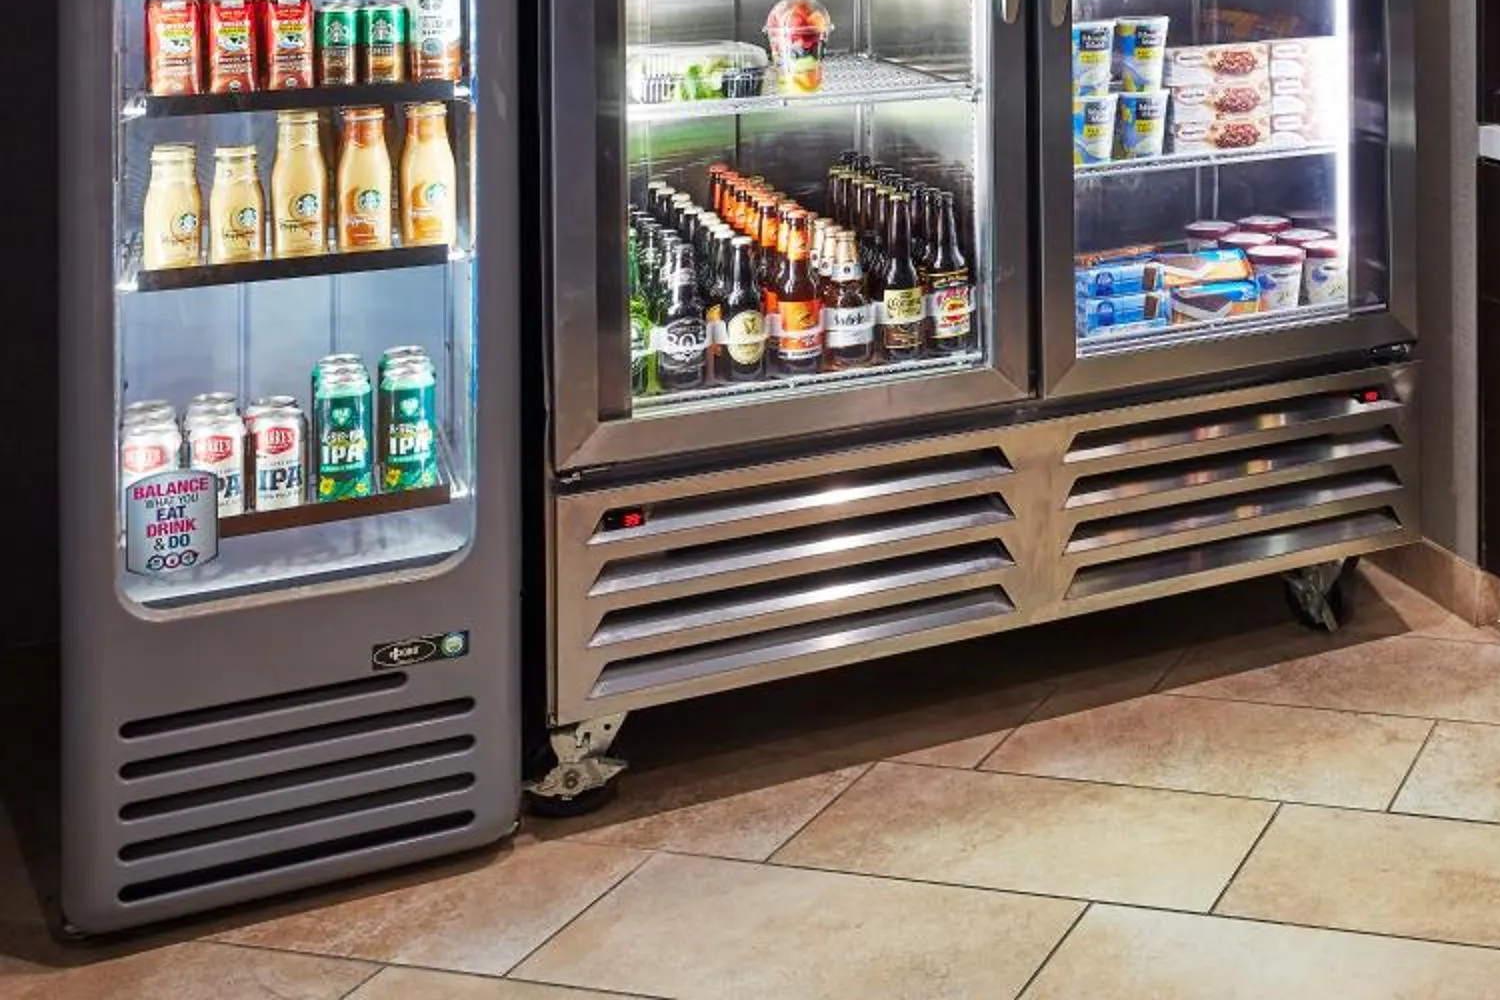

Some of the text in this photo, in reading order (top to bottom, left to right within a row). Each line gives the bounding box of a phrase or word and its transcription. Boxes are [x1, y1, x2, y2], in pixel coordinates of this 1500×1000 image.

[133, 476, 210, 501] BALANCE
[179, 492, 199, 505] YOU
[156, 505, 187, 521] EAT
[146, 518, 198, 538] DRINK
[153, 533, 191, 551] & DO
